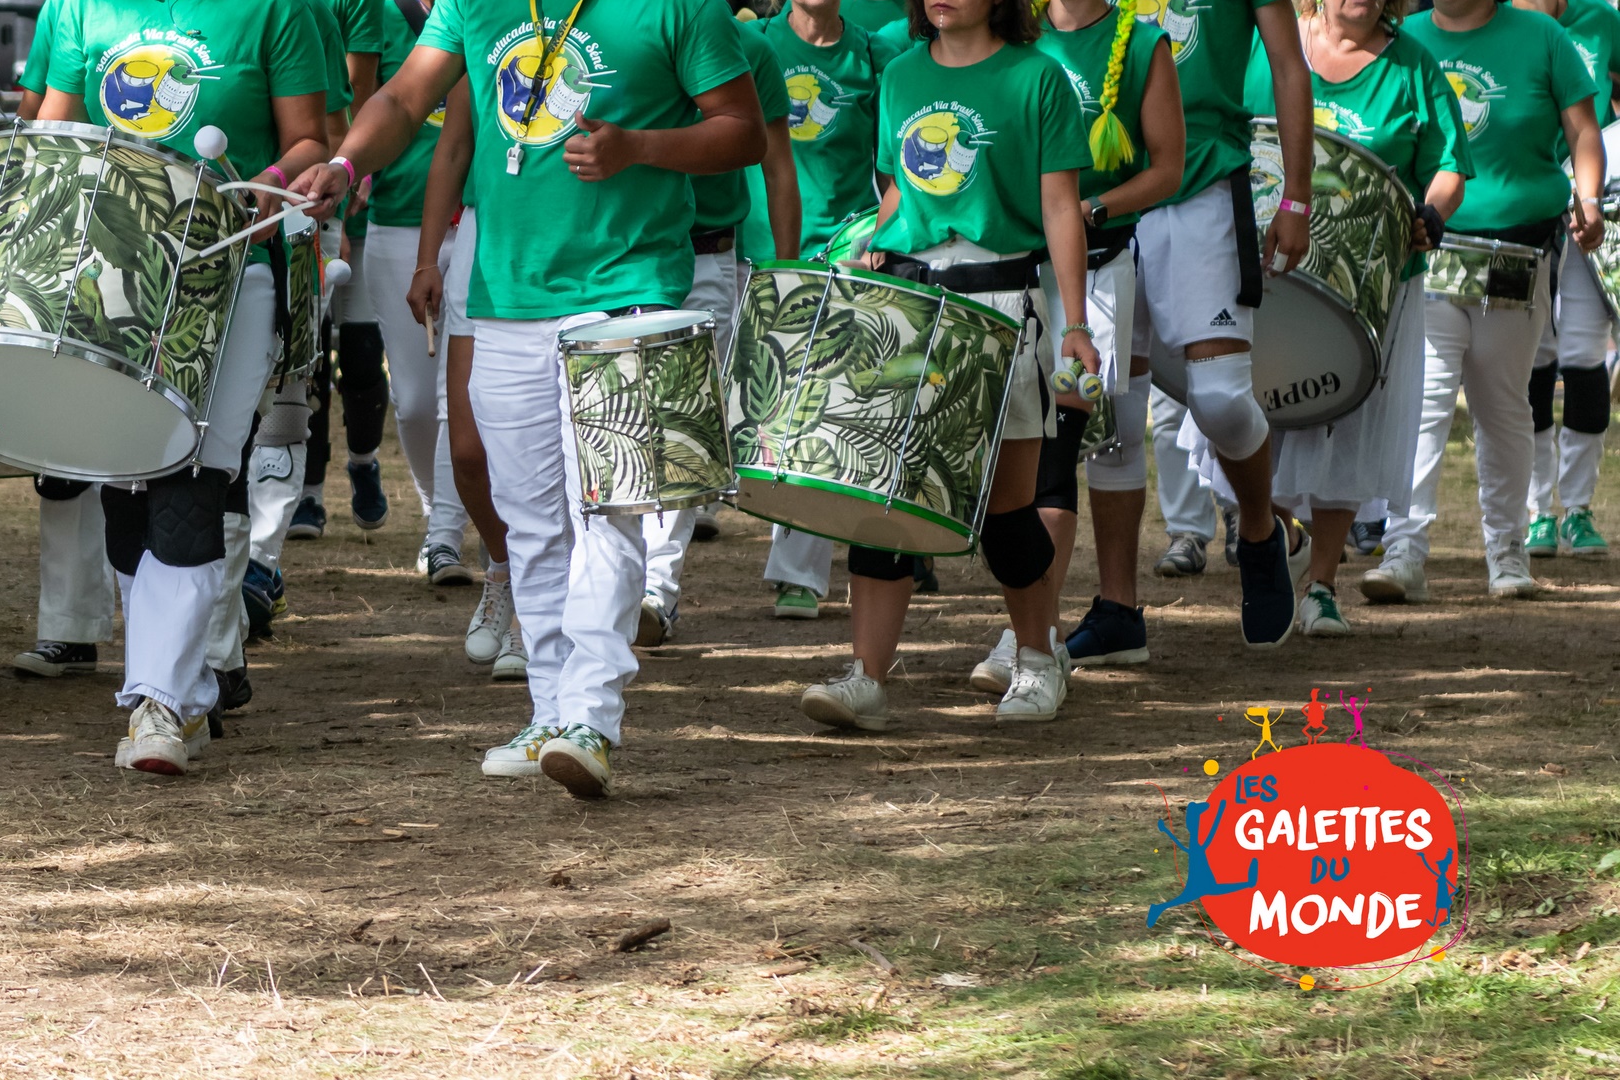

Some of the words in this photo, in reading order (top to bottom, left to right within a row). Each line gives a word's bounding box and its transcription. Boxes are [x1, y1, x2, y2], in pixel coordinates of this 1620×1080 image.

[95, 32, 141, 73] Batucada
[143, 28, 164, 40] Via
[166, 30, 199, 49] Brasil
[194, 44, 216, 66] Séné
[487, 21, 533, 66] Batucada
[585, 42, 608, 70] Séné
[547, 20, 570, 53] BRASIL
[1455, 59, 1483, 75] Brasil
[896, 104, 932, 139] Batucada
[933, 100, 948, 110] Via
[950, 101, 975, 117] Brasil
[971, 113, 989, 132] Séné
[1210, 318, 1237, 326] adidas
[1263, 372, 1341, 413] GOPE
